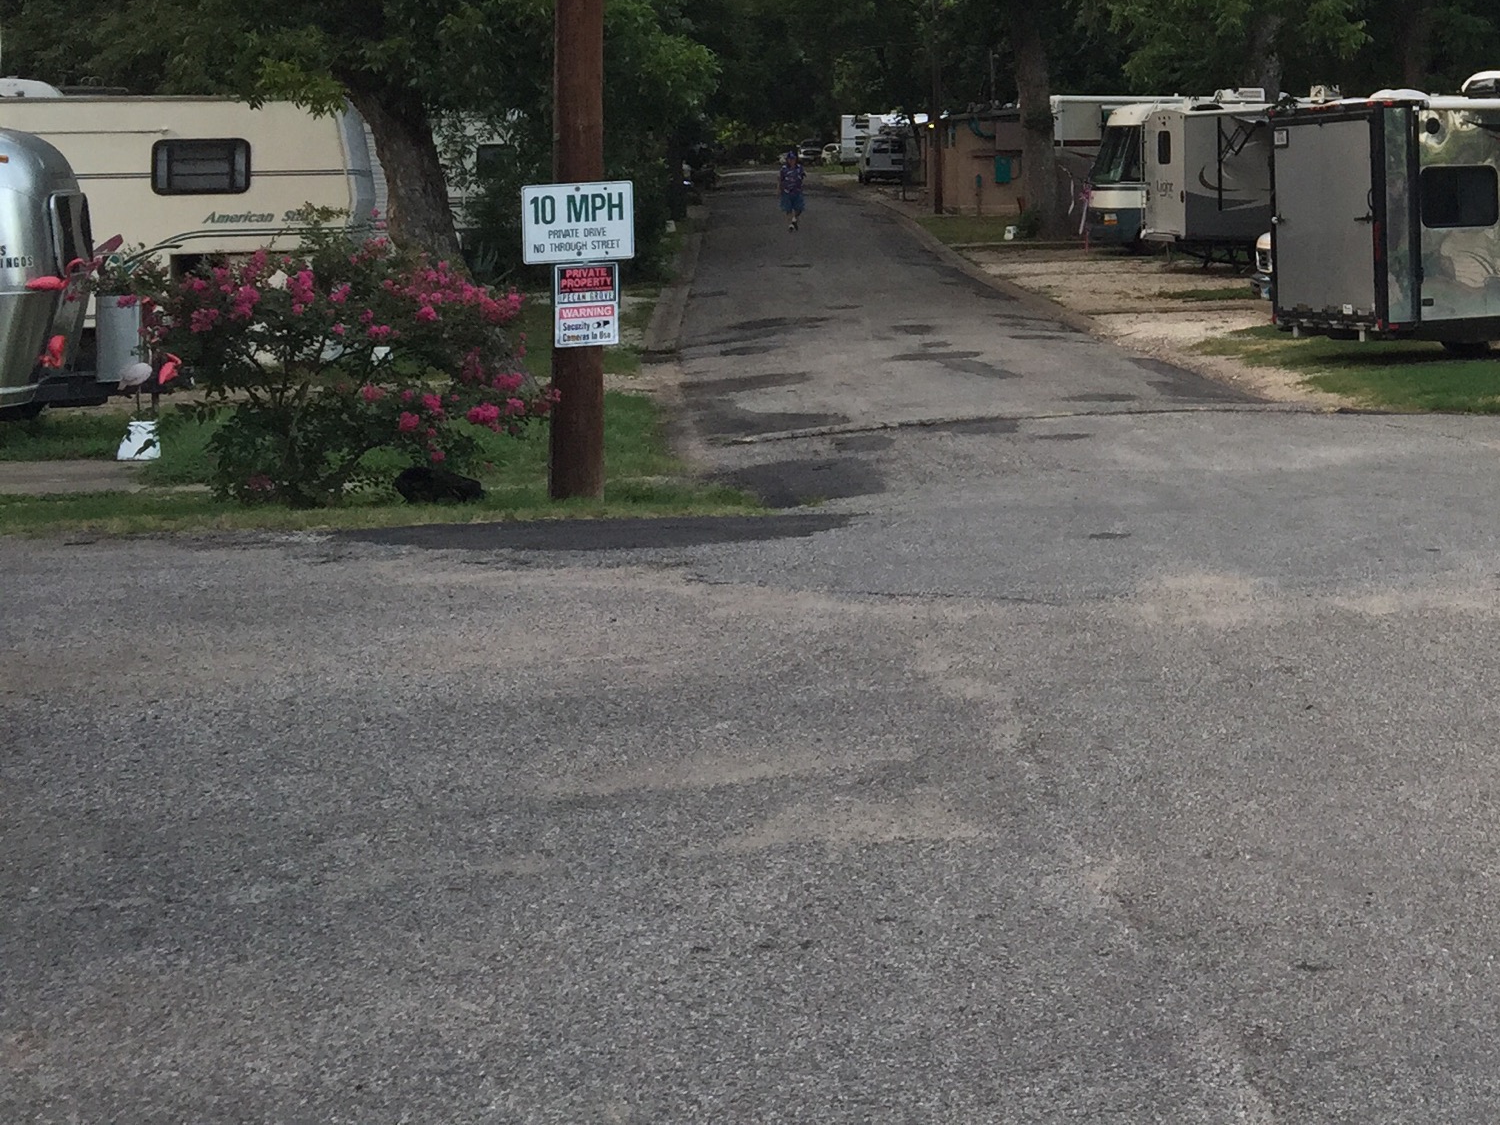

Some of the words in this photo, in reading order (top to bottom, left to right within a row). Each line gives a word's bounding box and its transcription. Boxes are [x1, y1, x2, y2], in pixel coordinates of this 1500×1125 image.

[530, 195, 556, 225] 10
[566, 192, 623, 223] MPH
[202, 210, 275, 224] American
[548, 228, 580, 239] PRIVATE
[583, 227, 607, 237] DRIVE
[533, 243, 546, 254] NO
[550, 242, 588, 252] THROUGH
[591, 239, 620, 249] STREET
[565, 268, 608, 278] PRIVATE
[561, 277, 612, 288] PROPERTY
[562, 306, 612, 318] WARNING
[562, 321, 590, 332] Security
